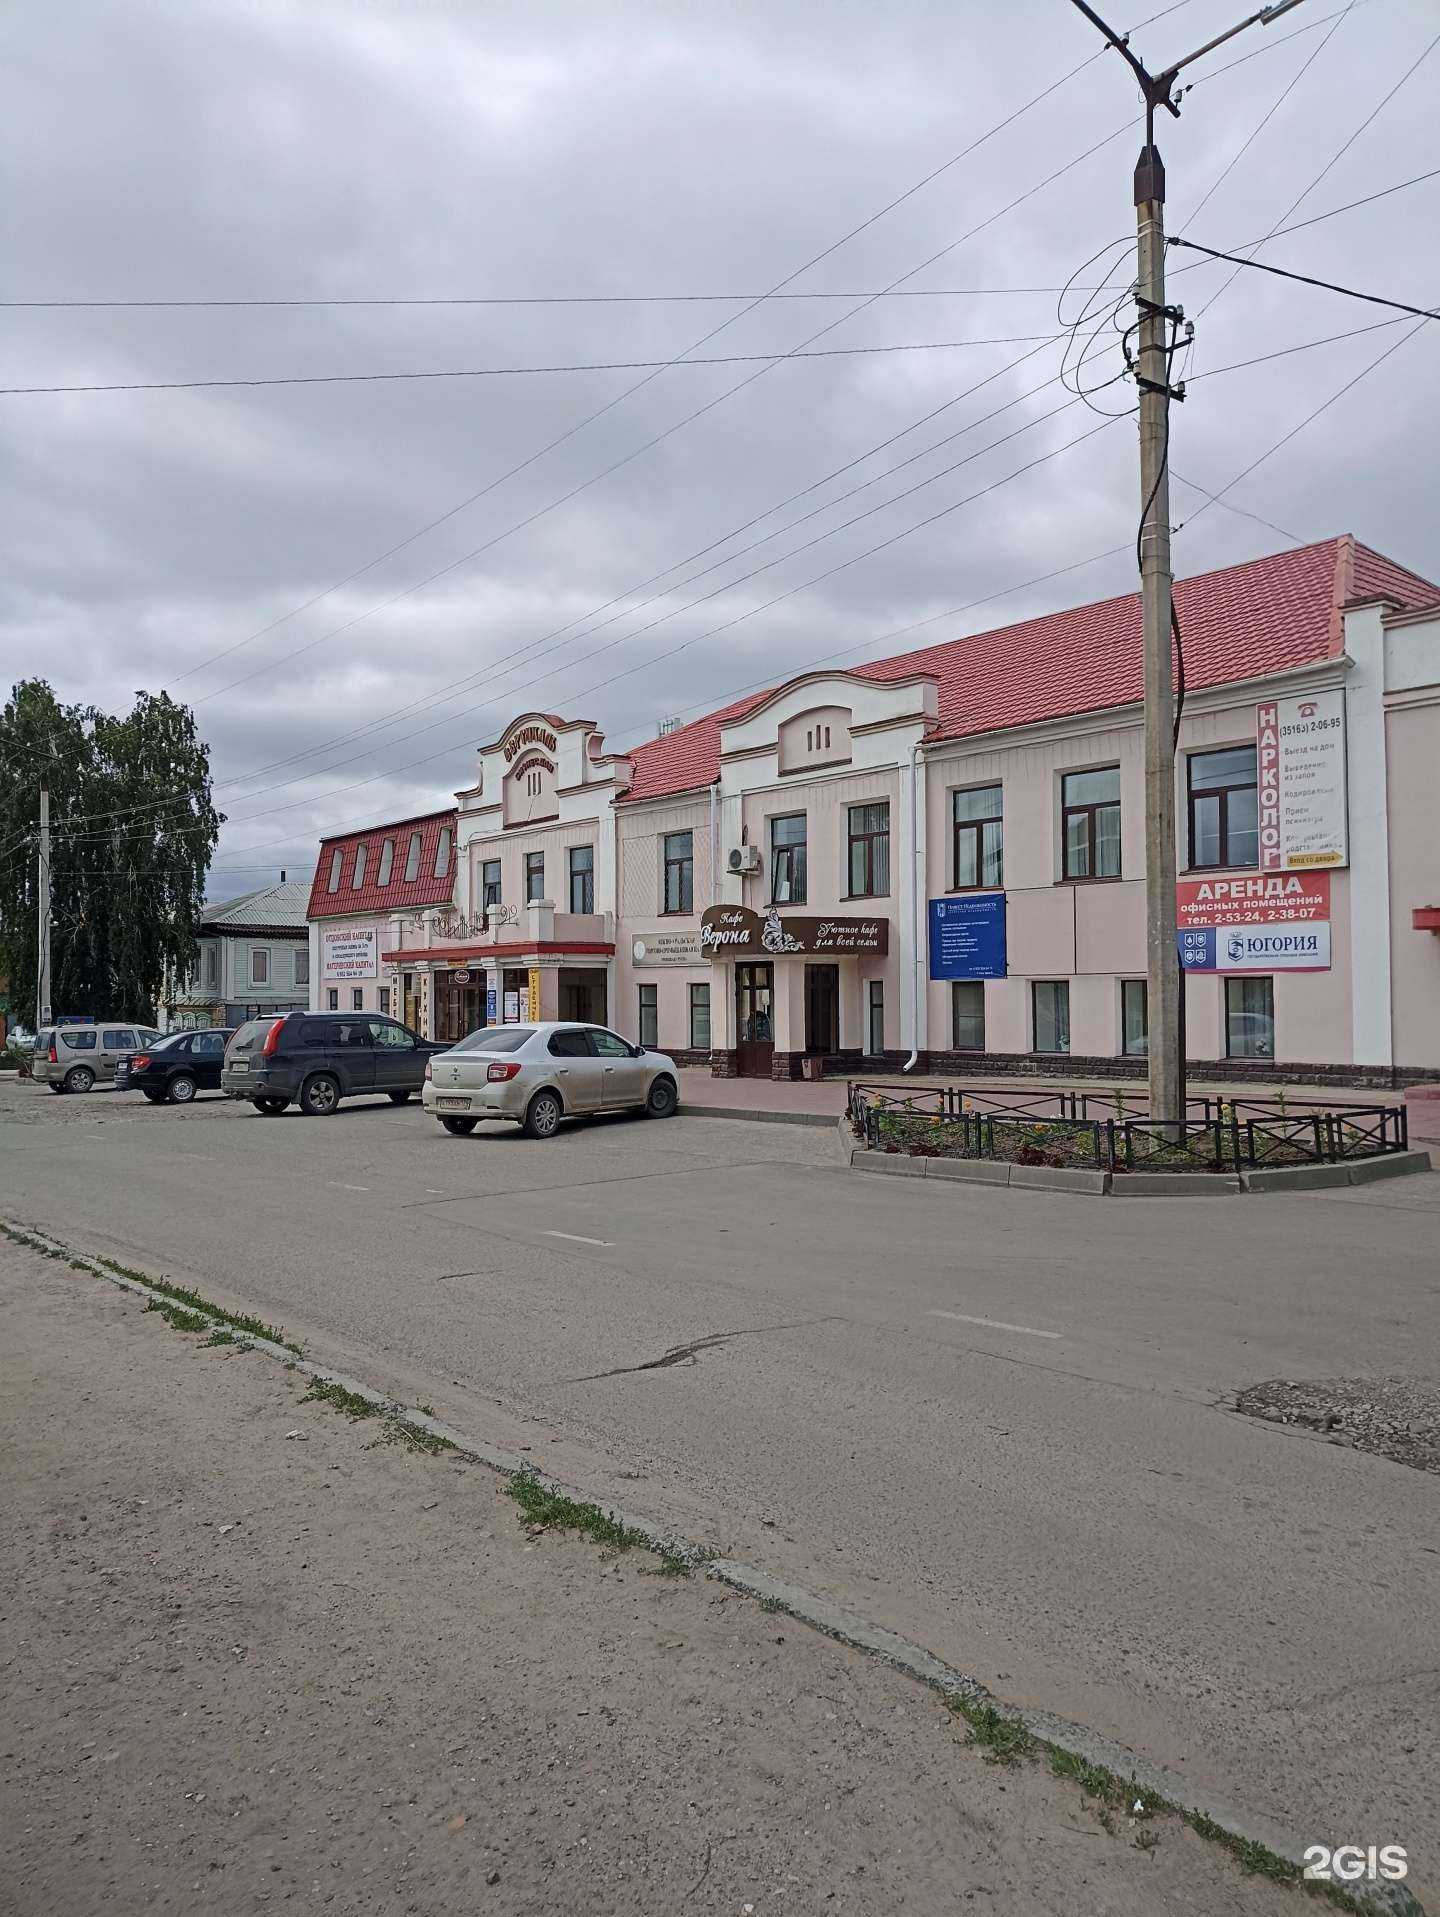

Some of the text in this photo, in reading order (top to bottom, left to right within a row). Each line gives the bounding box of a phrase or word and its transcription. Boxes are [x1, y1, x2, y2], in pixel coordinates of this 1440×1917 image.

[1311, 717, 1341, 732] 2-06-95
[1260, 709, 1279, 866] НАРКОЛОГ
[1197, 876, 1304, 901] АРЕНДА
[1180, 894, 1323, 914] офисных помещений
[720, 911, 744, 928] Кафе
[1187, 907, 1316, 925] тел. 2-53-24, 2-38-07
[701, 923, 751, 953] Верона
[817, 922, 878, 939] Уютное кафе
[813, 935, 878, 949] для всей семьи
[1247, 936, 1318, 952] ЮГОРИЯ
